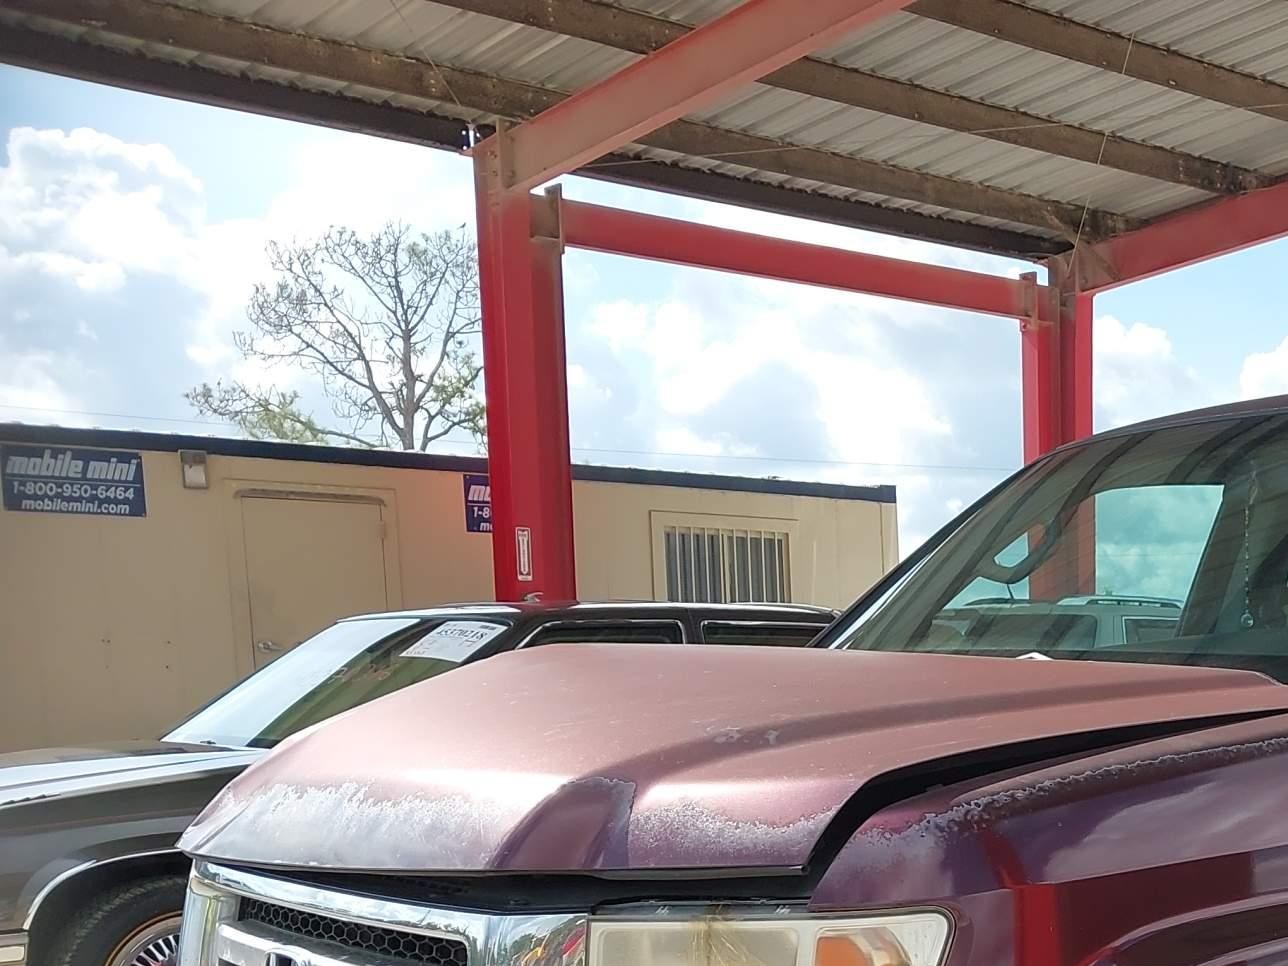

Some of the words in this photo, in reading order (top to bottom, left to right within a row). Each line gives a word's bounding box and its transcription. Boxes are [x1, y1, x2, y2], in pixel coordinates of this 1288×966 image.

[6, 449, 83, 478] mobile
[86, 457, 138, 480] mini
[13, 481, 134, 499] 1-800-950-6464
[21, 498, 130, 514] mobilemini.com
